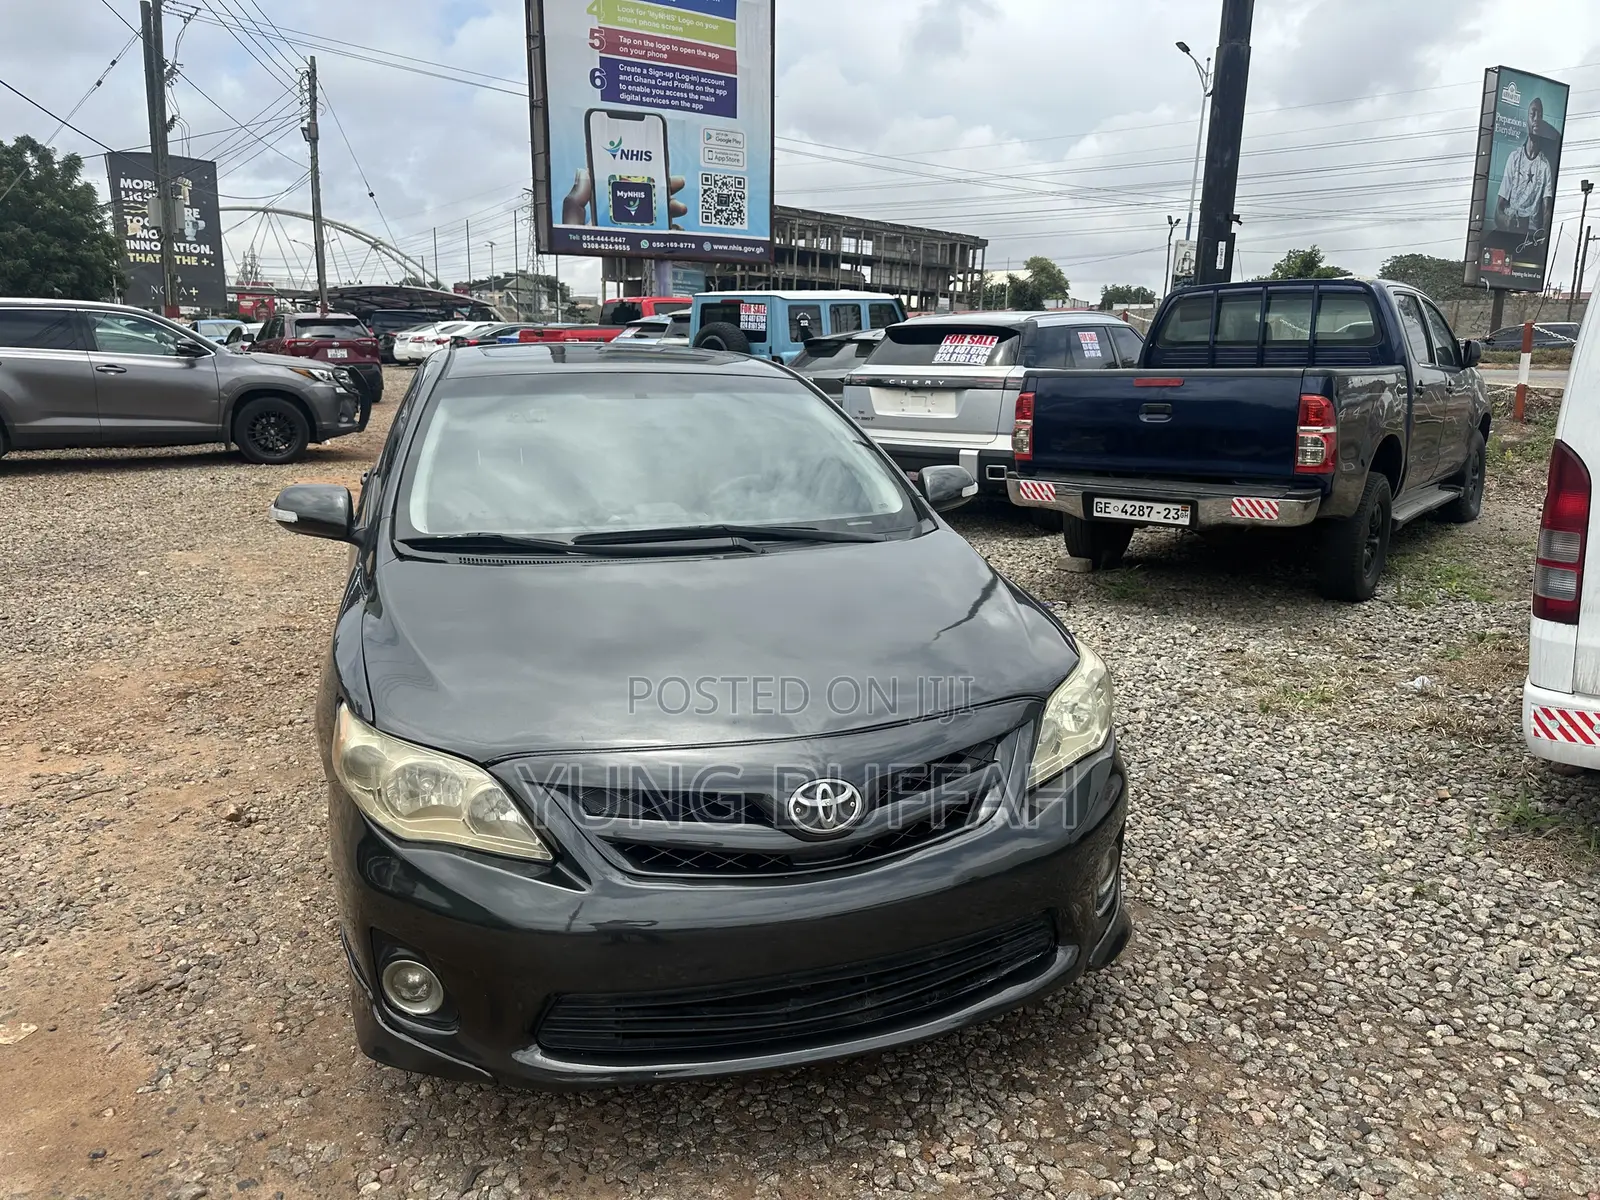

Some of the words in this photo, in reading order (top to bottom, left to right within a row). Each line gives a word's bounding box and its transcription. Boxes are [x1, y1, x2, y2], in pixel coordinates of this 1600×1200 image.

[617, 5, 634, 14] Look
[636, 8, 646, 16] for
[678, 16, 694, 26] Logo
[705, 22, 720, 30] your
[617, 16, 638, 24] smart
[639, 19, 660, 29] phone
[661, 24, 683, 32] screen
[588, 28, 606, 51] 5
[619, 36, 632, 45] Tap
[644, 40, 654, 48] the
[656, 41, 670, 51] logo
[680, 47, 695, 56] open
[696, 48, 707, 56] the
[708, 51, 720, 60] app
[629, 48, 646, 56] your
[647, 50, 668, 60] phone
[589, 67, 608, 90] 6
[618, 64, 642, 74] Create
[648, 68, 674, 79] Sign-up
[675, 72, 700, 83] (Log-in)
[700, 76, 725, 86] account
[634, 76, 655, 85] Ghana
[656, 78, 673, 87] Card
[674, 82, 694, 90] Profile
[704, 85, 714, 94] the
[716, 88, 728, 96] app
[628, 84, 650, 94] enable
[666, 90, 688, 98] access
[689, 91, 699, 100] the
[700, 94, 715, 102] main
[619, 92, 640, 102] digital
[642, 96, 670, 105] services
[680, 99, 691, 108] the
[692, 102, 704, 110] app
[716, 136, 732, 144] Google
[620, 149, 652, 162] NHIS
[120, 178, 156, 190] MOR
[616, 190, 646, 199] MyNHIS
[126, 240, 214, 254] INNOATION.
[712, 244, 764, 254] www.nhis.gov.gh
[174, 256, 198, 266] THE
[741, 304, 752, 314] FOR
[753, 304, 766, 314] SALE
[944, 334, 966, 345] FOR
[968, 336, 997, 346] SALE
[938, 346, 954, 354] 024
[970, 346, 992, 355] 6784
[934, 353, 950, 362] 024
[950, 354, 969, 362] 8161
[970, 354, 988, 364] 546
[1095, 502, 1112, 514] GE
